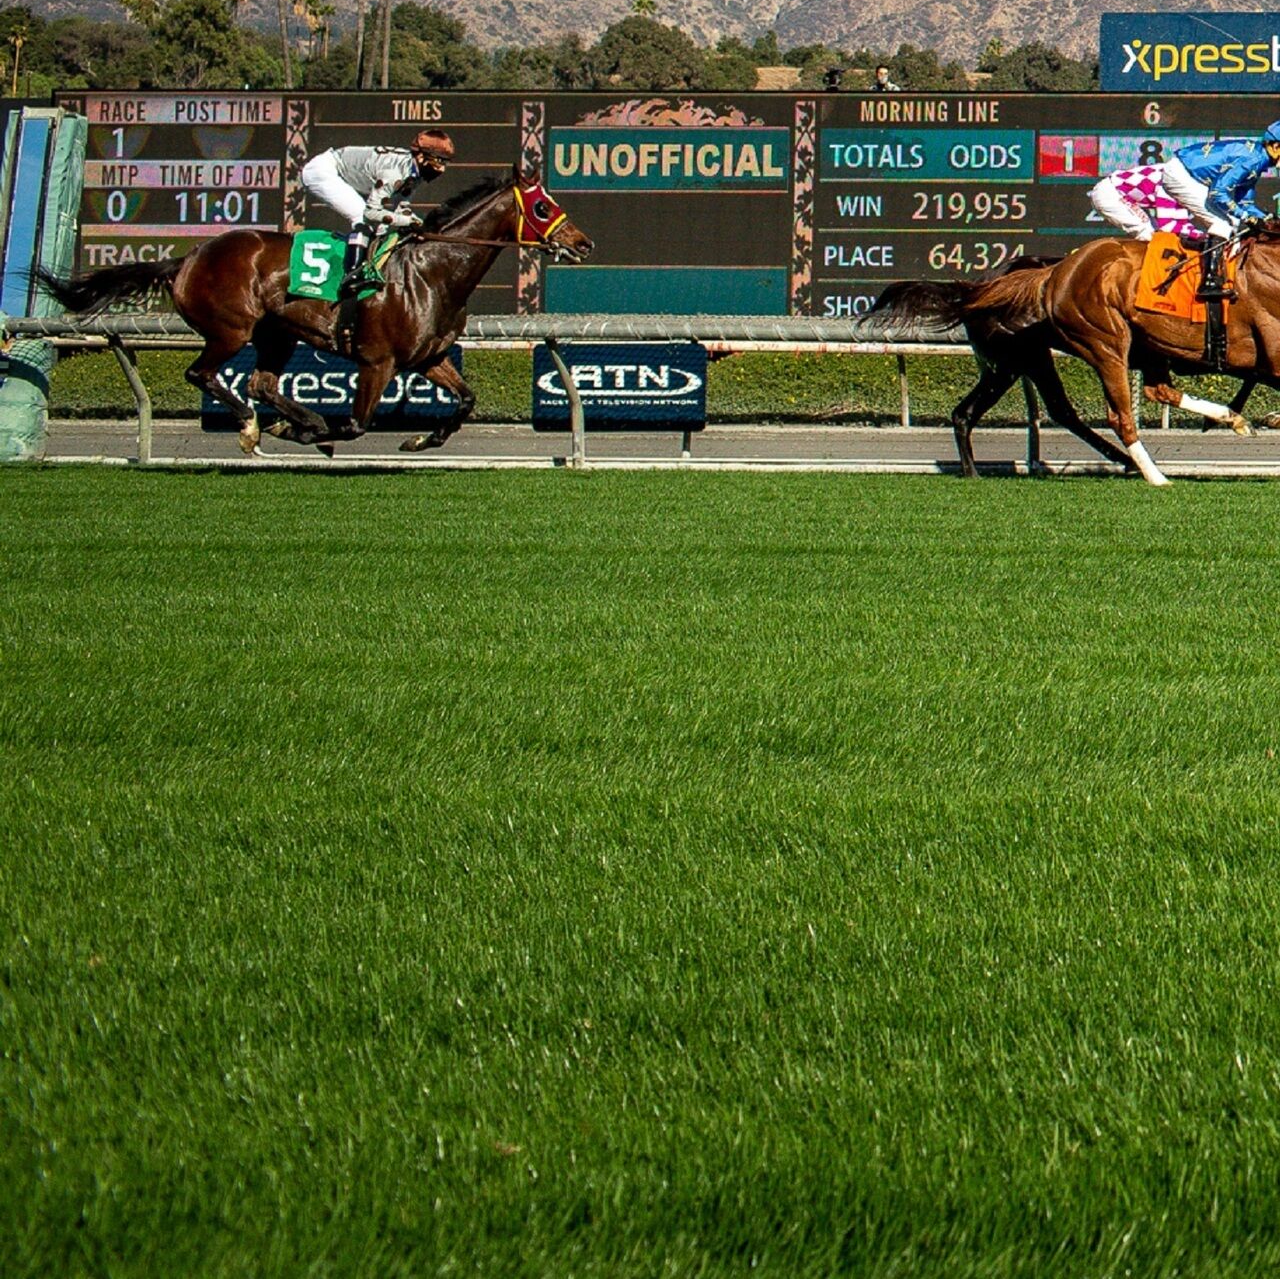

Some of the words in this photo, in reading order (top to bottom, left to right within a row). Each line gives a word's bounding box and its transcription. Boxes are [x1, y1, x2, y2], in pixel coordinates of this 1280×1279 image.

[100, 101, 146, 122] RACE
[175, 101, 220, 122] POST
[227, 101, 272, 122] TIME
[391, 100, 442, 121] TIMES
[860, 101, 948, 122] MORNING
[958, 101, 999, 122] LINE
[1144, 102, 1160, 125] 6
[112, 127, 124, 157] 1
[1138, 140, 1164, 166] 8
[553, 143, 784, 177] UNOFFICIAL
[829, 144, 924, 169] TOTALS
[950, 144, 1022, 169] ODDS
[1062, 139, 1074, 172] 1
[101, 165, 139, 186] MTP
[159, 165, 204, 186] TIME
[212, 165, 234, 186] OF
[242, 165, 277, 186] DAY
[106, 190, 127, 222] 0
[175, 190, 259, 222] 11:01
[836, 196, 882, 217] WIN
[912, 192, 1027, 223] 219,955
[84, 243, 175, 266] TRACK
[300, 242, 332, 285] 5
[824, 246, 894, 267] PLACE
[1152, 248, 1187, 296] 7
[823, 296, 877, 318] SHO
[570, 365, 669, 388] RTN
